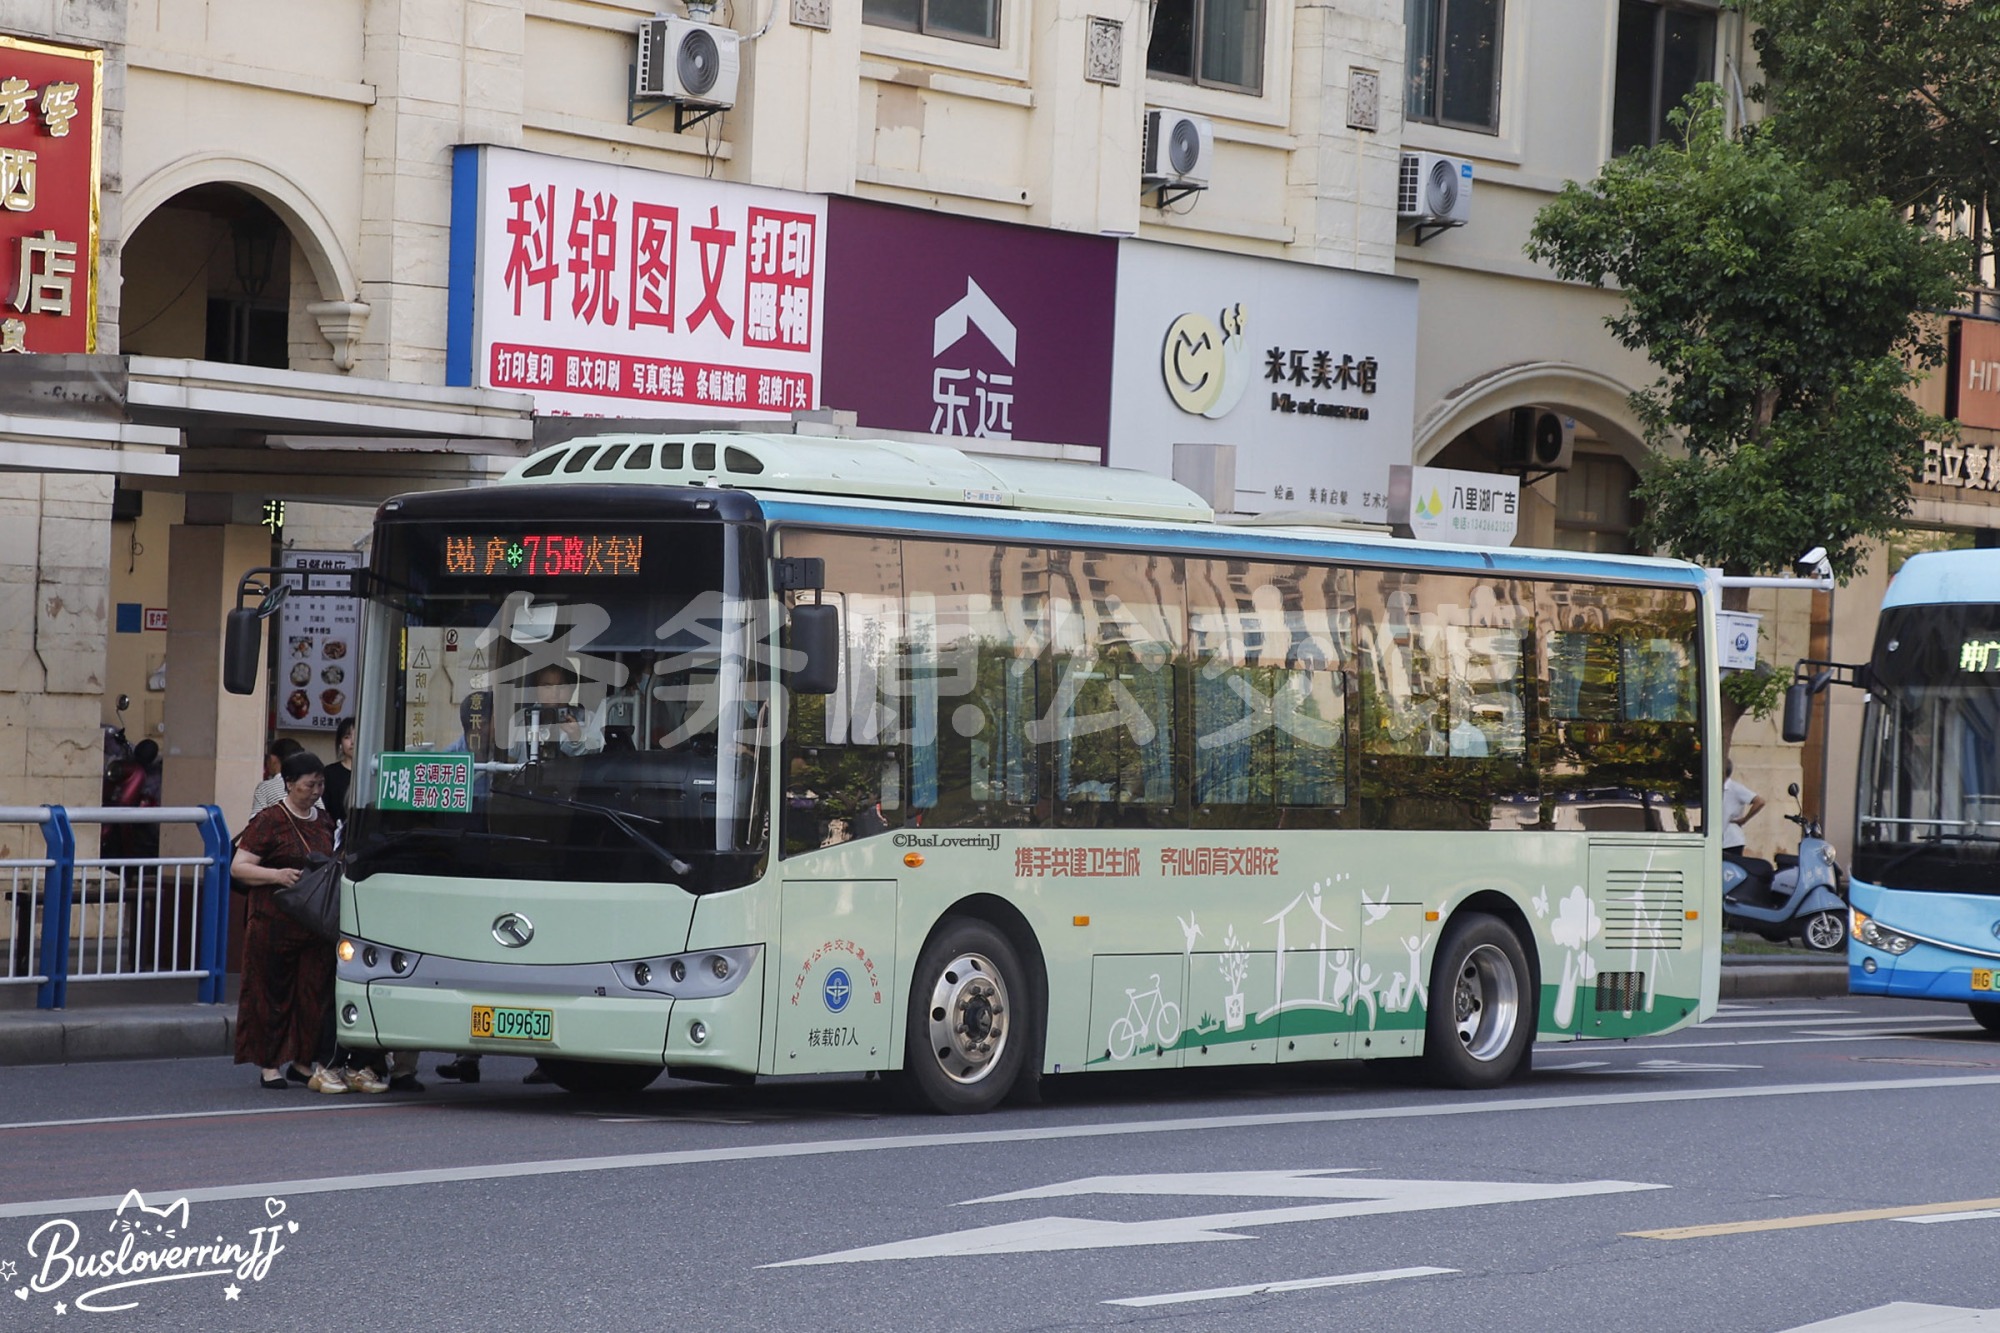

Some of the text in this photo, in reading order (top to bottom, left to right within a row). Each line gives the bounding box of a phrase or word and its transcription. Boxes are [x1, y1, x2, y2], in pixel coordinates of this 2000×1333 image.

[504, 184, 736, 339] 科锐图文
[751, 215, 812, 278] 打印
[14, 230, 77, 316] 店
[748, 281, 809, 345] 照相
[498, 349, 553, 385] 打印复印
[566, 355, 621, 392] 图文印刷
[632, 363, 685, 398] 写真喷绘
[758, 374, 807, 409] 招牌门头
[1264, 346, 1378, 394] 米乐美术馆
[930, 367, 1013, 440] 乐远
[1274, 485, 1295, 501] 绘画
[1452, 486, 1516, 515] 八里湖广告
[382, 767, 410, 803] 75路
[414, 763, 467, 784] 空调开启
[412, 786, 467, 808] 票价3元
[1015, 847, 1279, 877] 携手共建卫生城 齐心同育文明花
[808, 1027, 859, 1047] 核载67人
